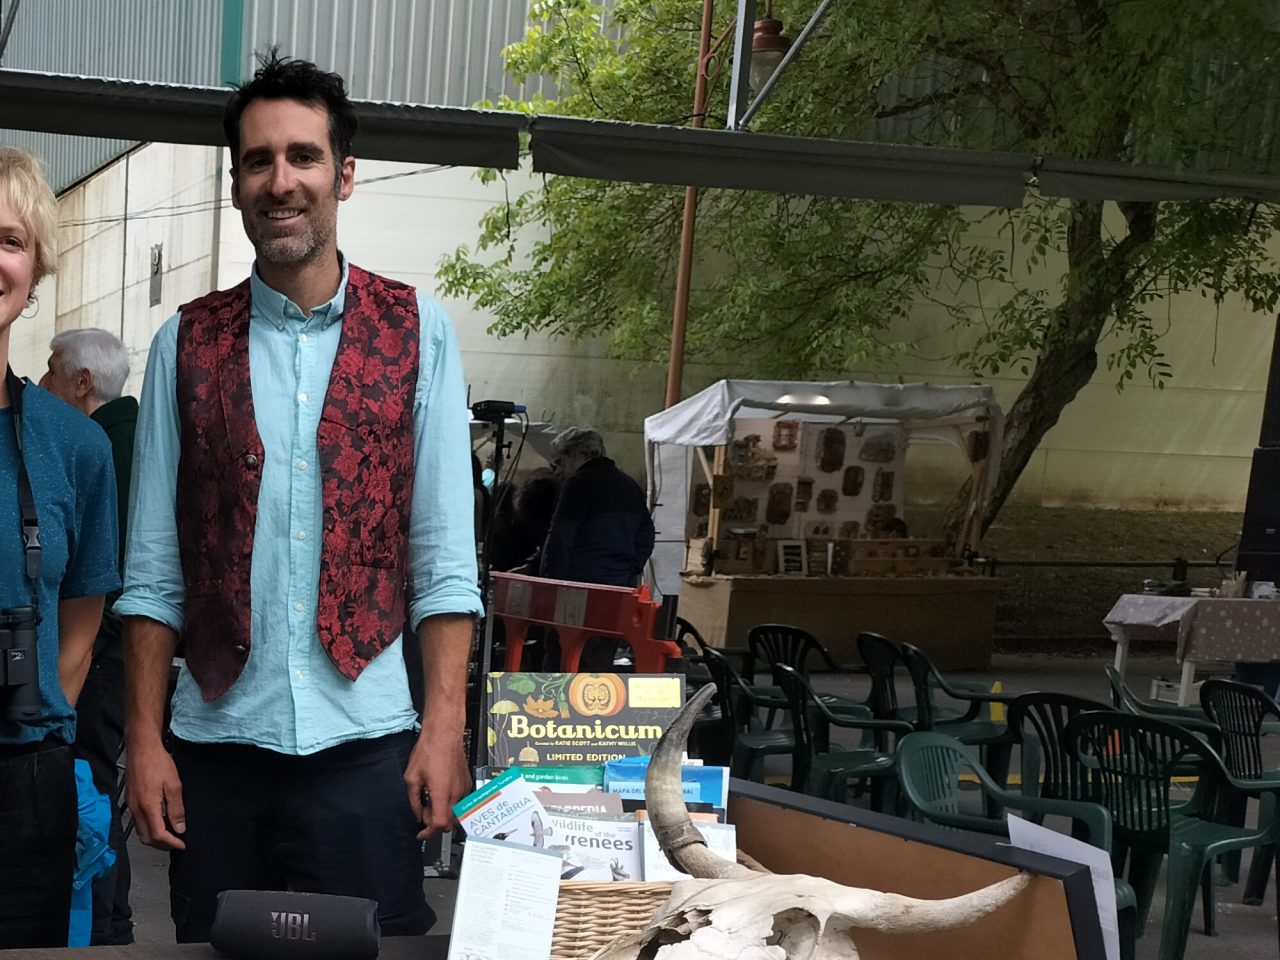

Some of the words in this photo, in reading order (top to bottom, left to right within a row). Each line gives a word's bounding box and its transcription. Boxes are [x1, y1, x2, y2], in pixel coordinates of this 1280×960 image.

[507, 715, 662, 739] Botanicum
[547, 753, 583, 761] LIMITED
[470, 808, 495, 829] AVES
[496, 800, 509, 812] de
[474, 796, 532, 837] CANTABRIA
[271, 912, 317, 941] JBL
